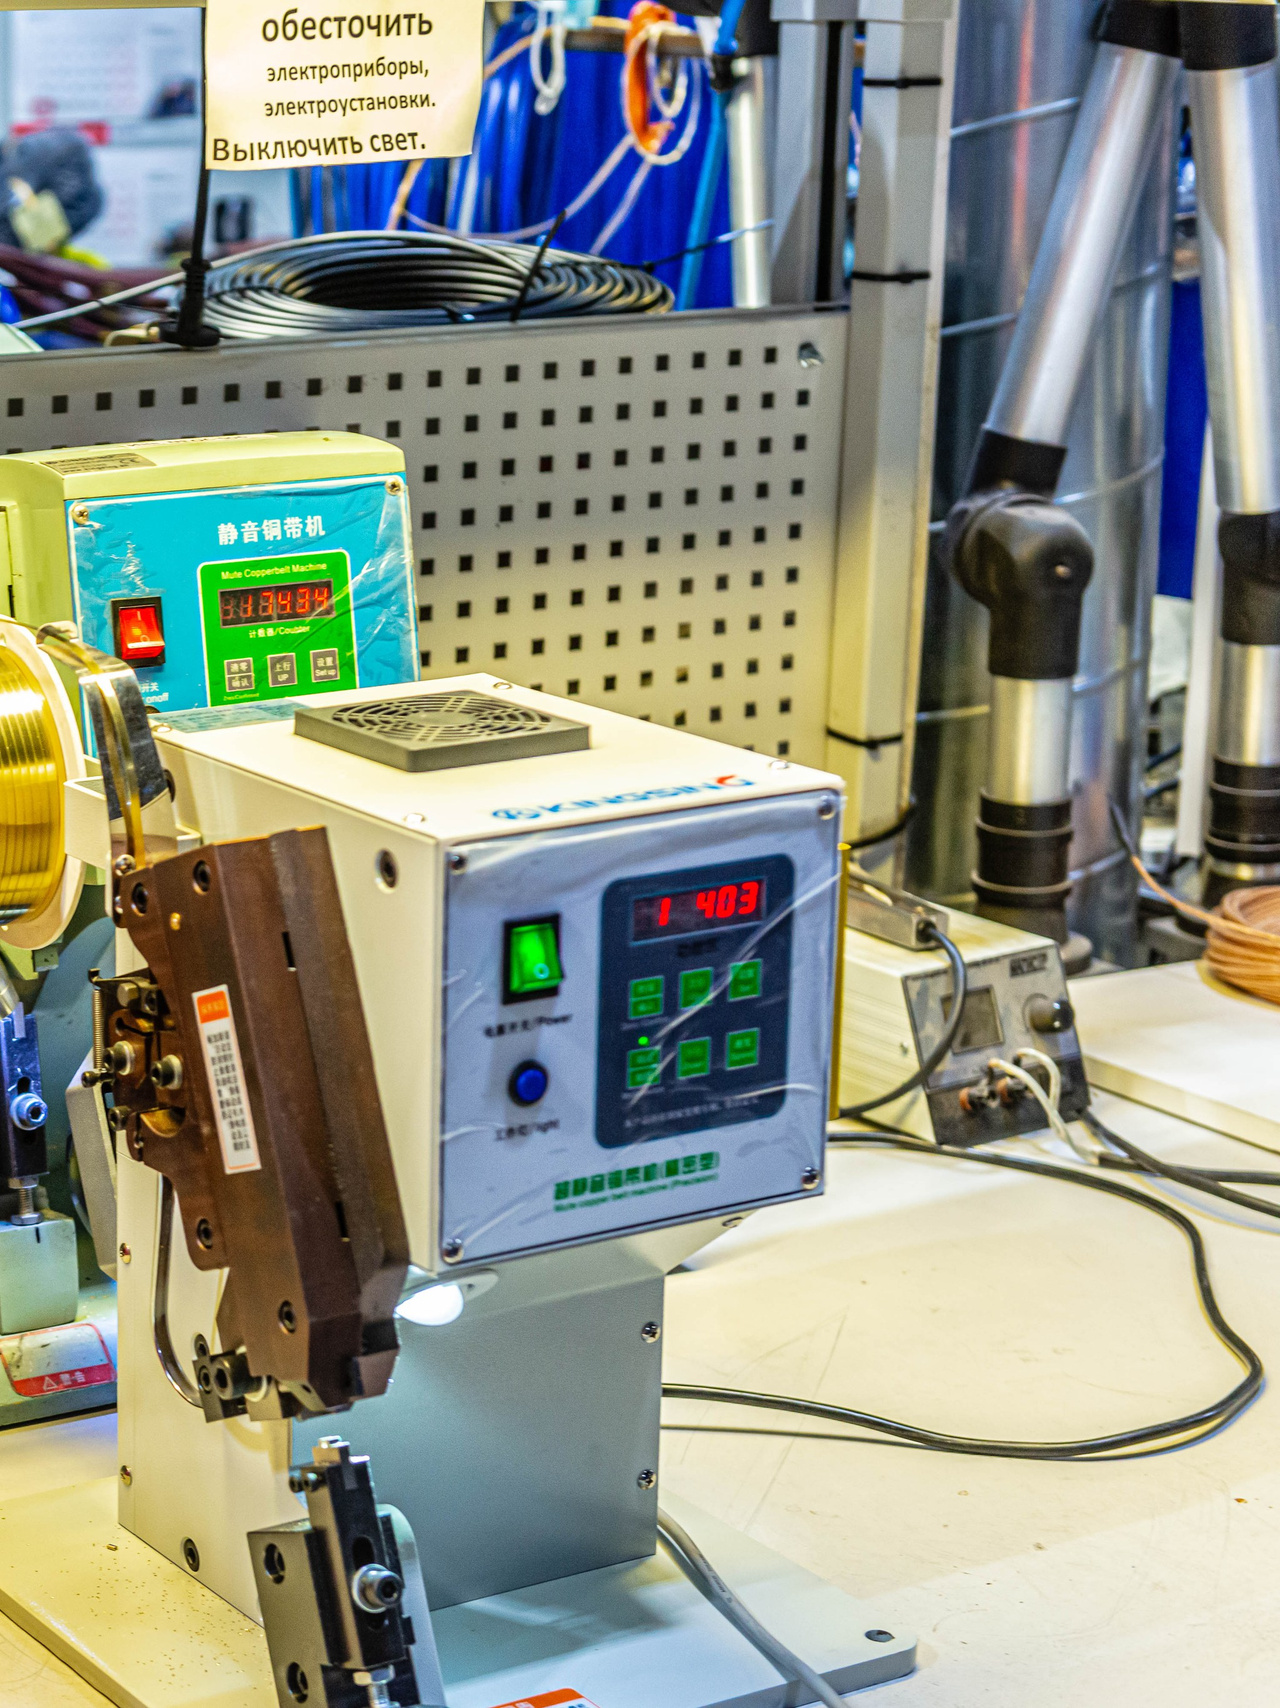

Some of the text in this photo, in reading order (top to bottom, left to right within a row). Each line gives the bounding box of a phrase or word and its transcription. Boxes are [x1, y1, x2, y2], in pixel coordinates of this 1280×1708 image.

[262, 8, 433, 42] обесточить
[266, 56, 430, 84] электроприборы,
[264, 92, 437, 118] электроустановки.
[212, 131, 426, 162] Выключить свет.
[217, 515, 326, 545] 静音铜带机
[221, 563, 327, 579] Mute Copperbelt Machine
[277, 673, 289, 682] UP
[695, 881, 759, 919] 403
